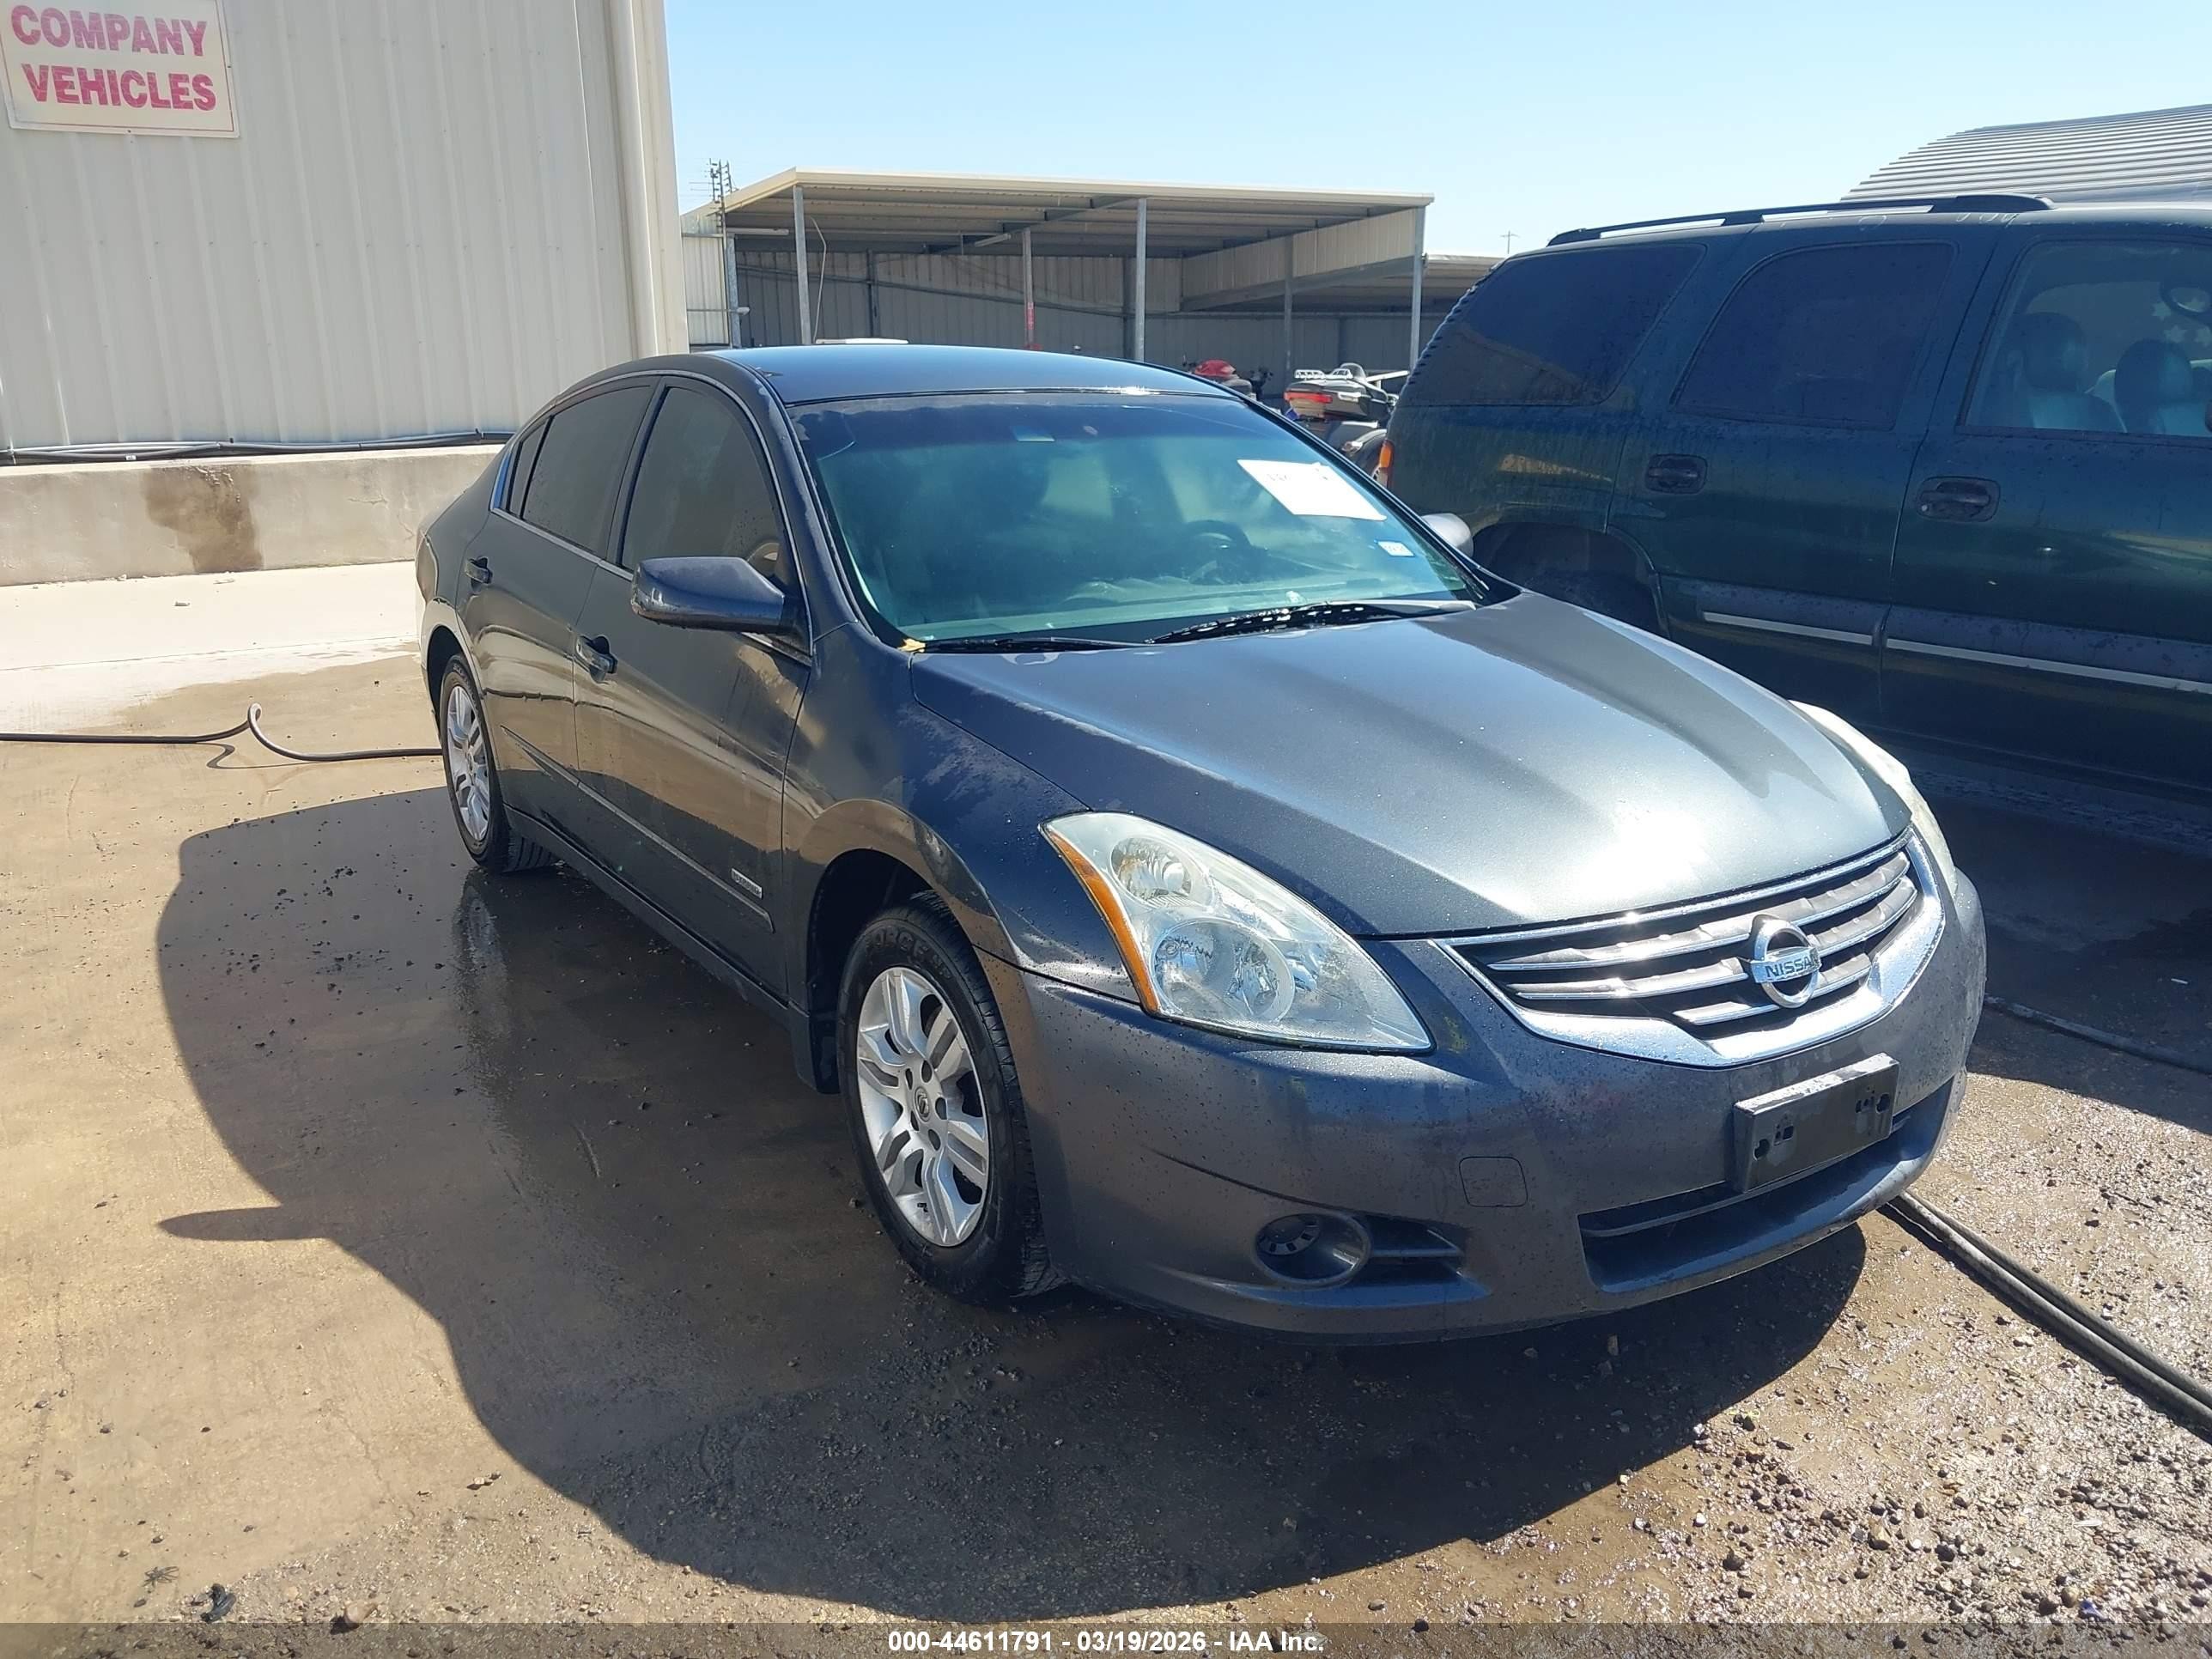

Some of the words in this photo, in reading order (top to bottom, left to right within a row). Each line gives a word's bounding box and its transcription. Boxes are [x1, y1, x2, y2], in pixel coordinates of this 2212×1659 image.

[11, 5, 207, 57] COMPANY
[21, 64, 216, 111] VEHICLES
[1765, 952, 1820, 978] NISSAN
